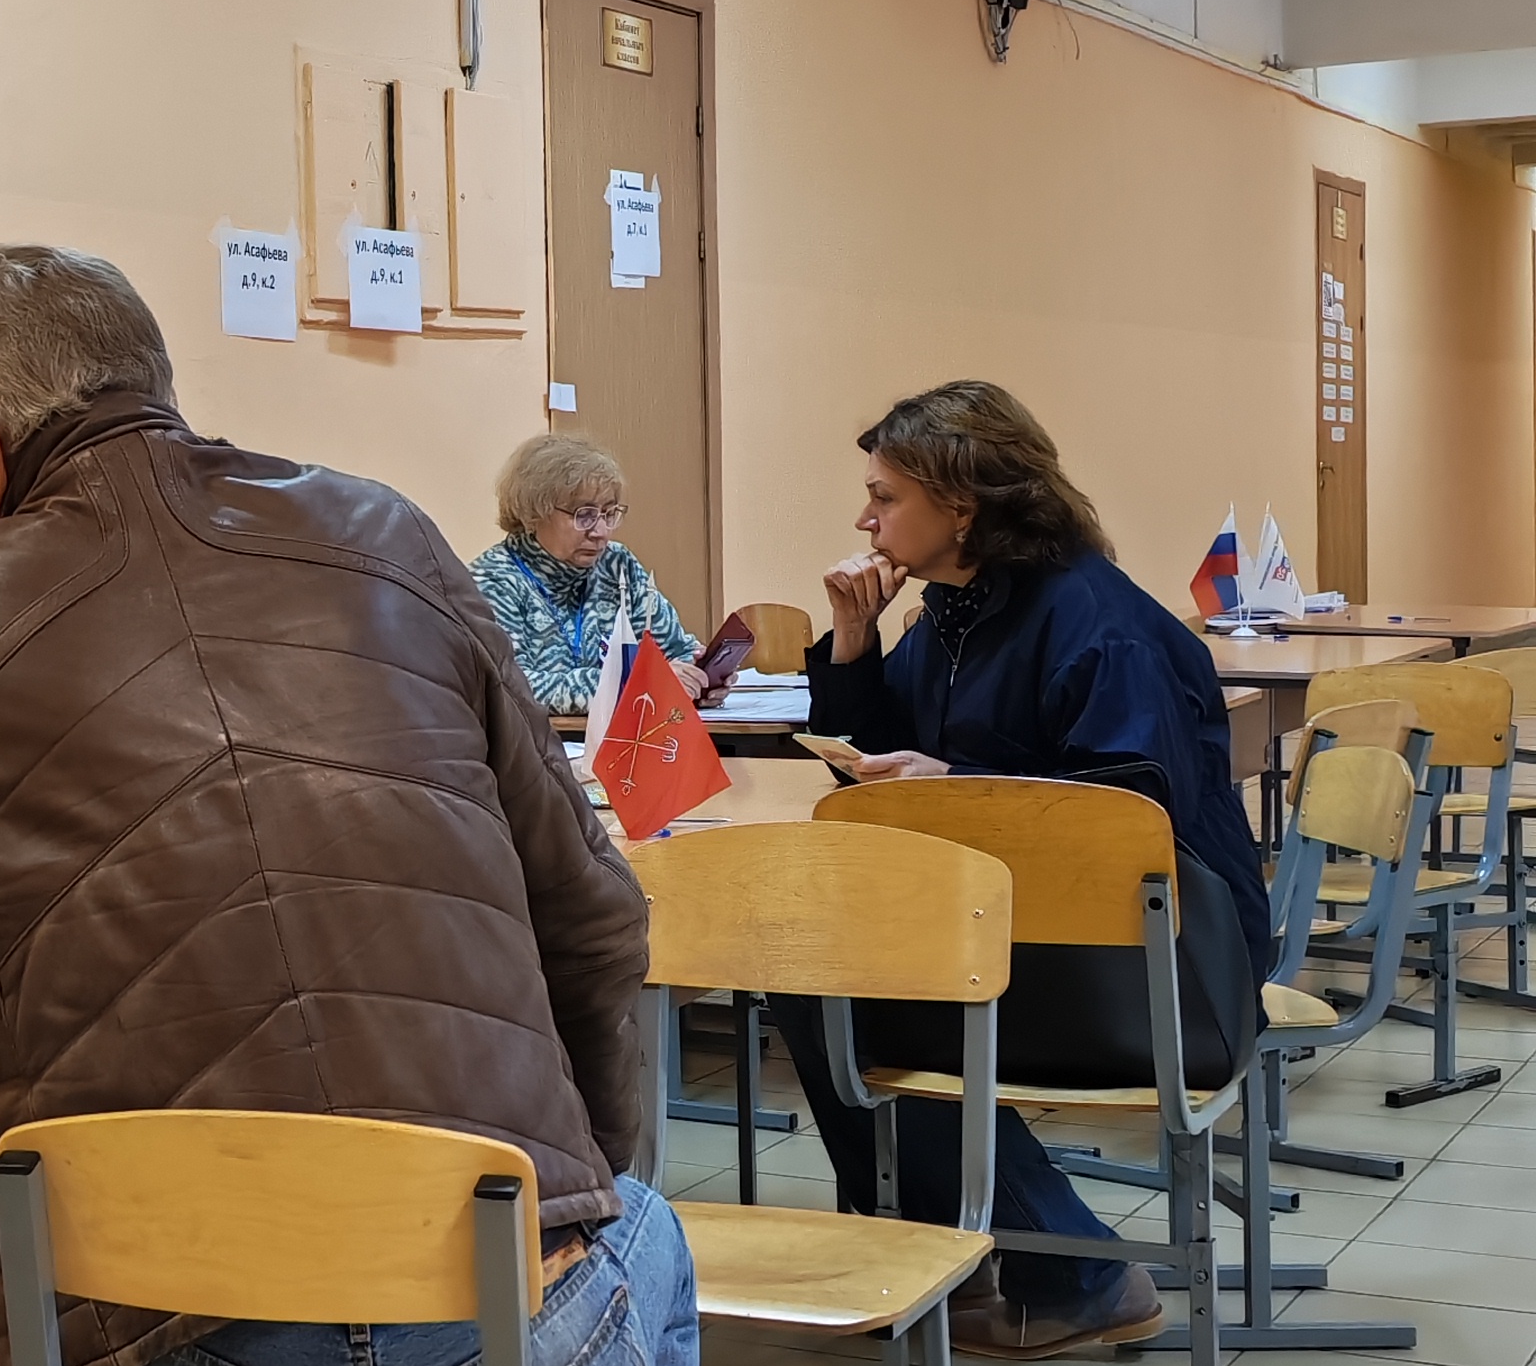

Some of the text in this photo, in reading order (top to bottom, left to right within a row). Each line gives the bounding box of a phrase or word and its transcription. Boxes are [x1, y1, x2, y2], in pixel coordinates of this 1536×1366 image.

[227, 241, 288, 262] ул. Асафьева
[354, 238, 414, 258] ул. Асафьева
[241, 272, 276, 290] д.9, к.2
[370, 267, 404, 285] д.9, к.1
